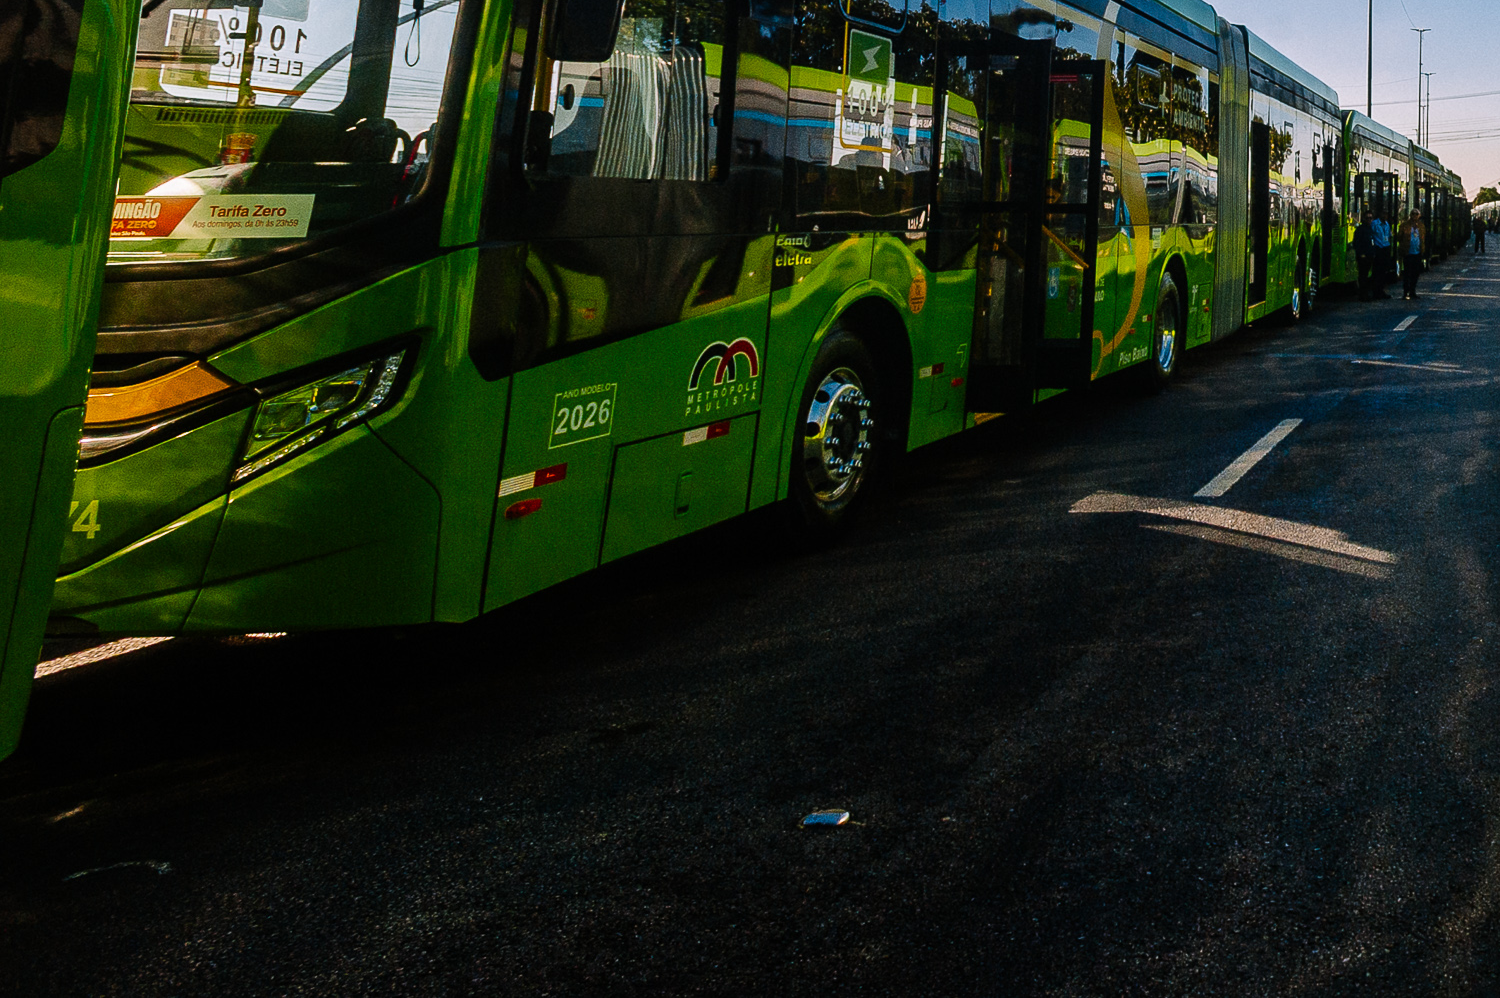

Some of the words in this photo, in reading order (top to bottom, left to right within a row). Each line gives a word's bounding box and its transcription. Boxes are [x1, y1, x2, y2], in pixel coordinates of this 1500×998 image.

[209, 205, 249, 218] Tarifa
[252, 205, 287, 218] Zero
[561, 388, 578, 400] ANO
[580, 383, 611, 397] MODELO
[686, 380, 759, 404] METRÓPOLE
[554, 399, 611, 436] 2026
[684, 393, 757, 418] PAULISTA
